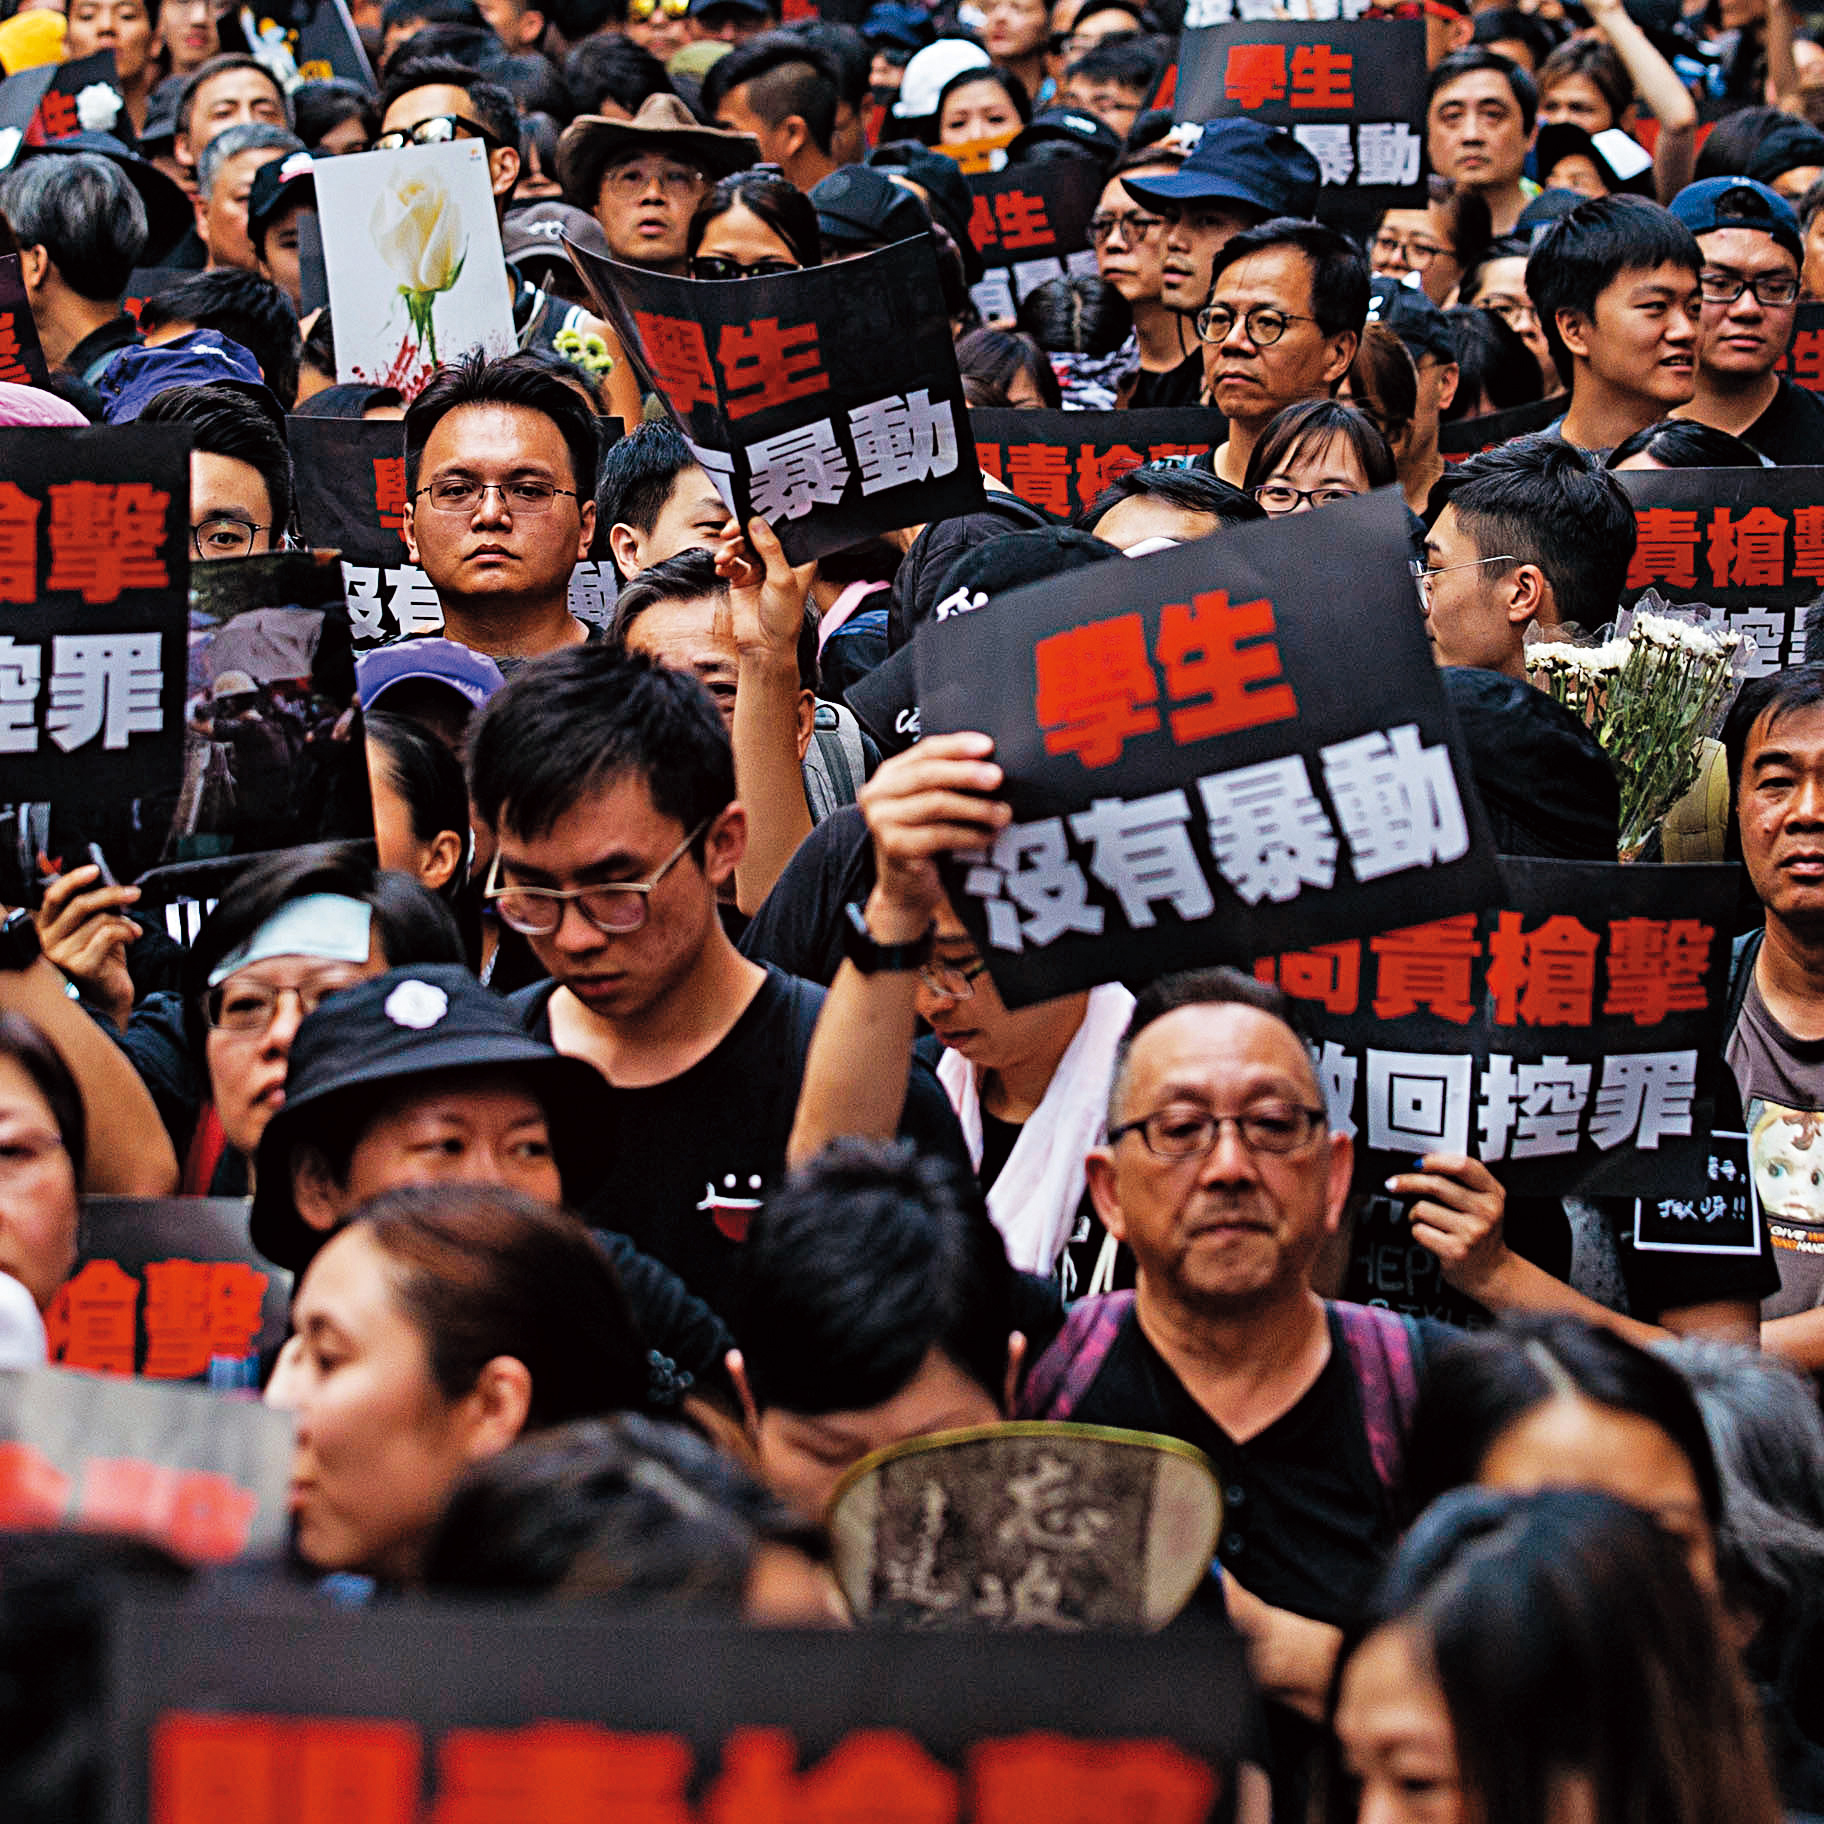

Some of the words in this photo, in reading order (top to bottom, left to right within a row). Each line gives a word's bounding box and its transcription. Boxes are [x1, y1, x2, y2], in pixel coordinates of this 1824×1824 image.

[1225, 43, 1355, 110] 學生
[1034, 587, 1300, 768] 學生
[968, 723, 1472, 957] 沒有暴動
